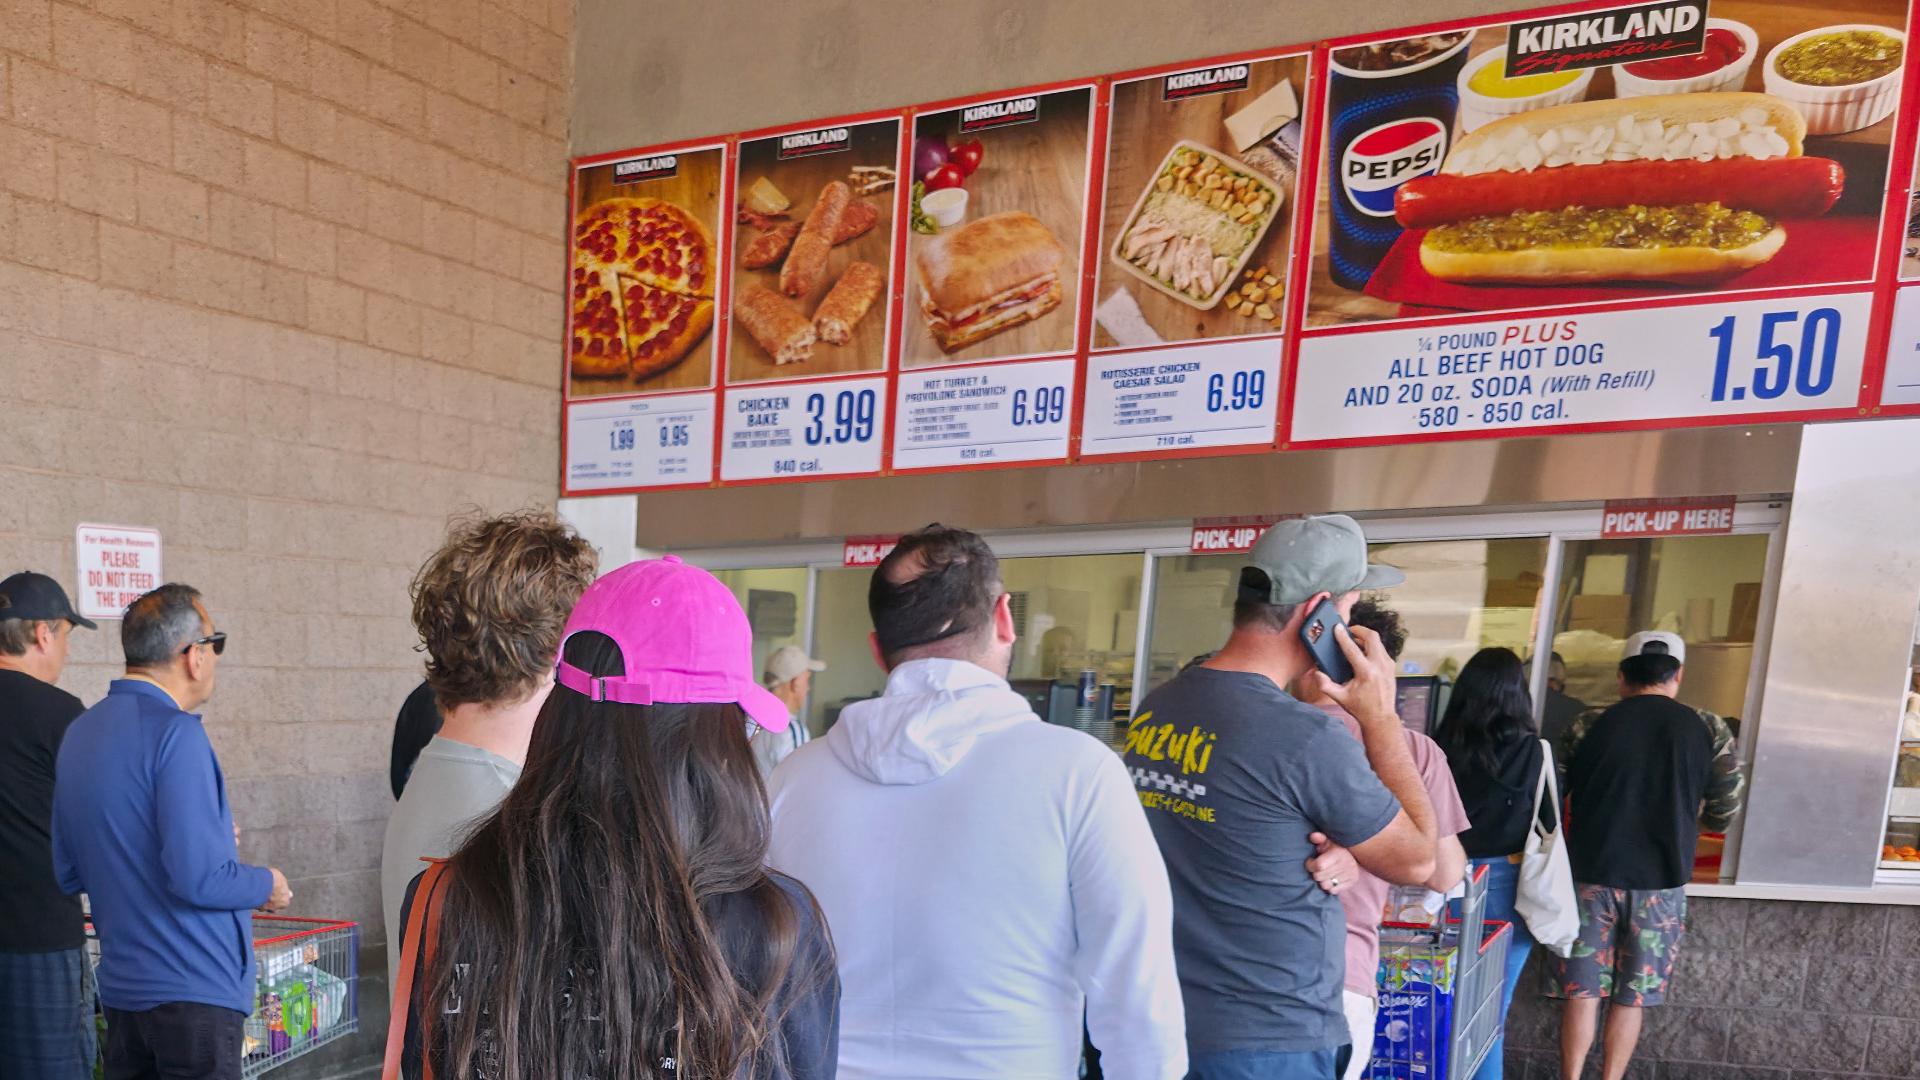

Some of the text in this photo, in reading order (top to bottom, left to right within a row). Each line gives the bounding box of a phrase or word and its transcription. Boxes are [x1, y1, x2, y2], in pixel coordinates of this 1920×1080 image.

[1517, 5, 1701, 54] KIRKLAND
[1513, 40, 1697, 75] Signature
[1167, 66, 1248, 90] KIRKLAND
[964, 98, 1037, 122] KIRKLAND
[782, 128, 849, 149] KIRKLAND
[616, 156, 677, 175] KIRKLAND
[1348, 143, 1440, 180] PEPSI
[1438, 331, 1497, 350] POUND
[1502, 321, 1578, 345] PLUS
[1388, 343, 1604, 379] ALL BEEF HOT DOG
[1709, 307, 1841, 402] 1.50
[1101, 362, 1200, 380] ROTISSERIE CHICKEN
[1113, 374, 1186, 389] CAESAR SALAD
[905, 386, 1007, 403] PROVOLONE SANDWICH
[923, 379, 941, 390] HOT
[944, 376, 978, 388] TURKEY
[1207, 369, 1265, 412] 6.99
[1344, 369, 1656, 407] AND 20 oz. SODA (With Refill)
[738, 397, 790, 413] CHICKEN
[1012, 386, 1065, 426] 6.99
[1418, 405, 1459, 428] 580
[1483, 402, 1523, 423] 850
[1531, 399, 1569, 420] cal.
[747, 412, 779, 427] BAKE
[805, 389, 876, 446] 3.99
[610, 428, 635, 451] 1.99
[659, 424, 689, 447] 9.95
[774, 458, 823, 473] 840 cal.
[1603, 507, 1731, 533] PICK-UP HERE
[1193, 528, 1256, 549] PICK-UP
[101, 550, 140, 568] PLEASE
[845, 544, 897, 563] PICK-U
[88, 570, 154, 589] DO NOT FEED
[96, 590, 116, 608] THE
[1124, 711, 1217, 774] Suzuki
